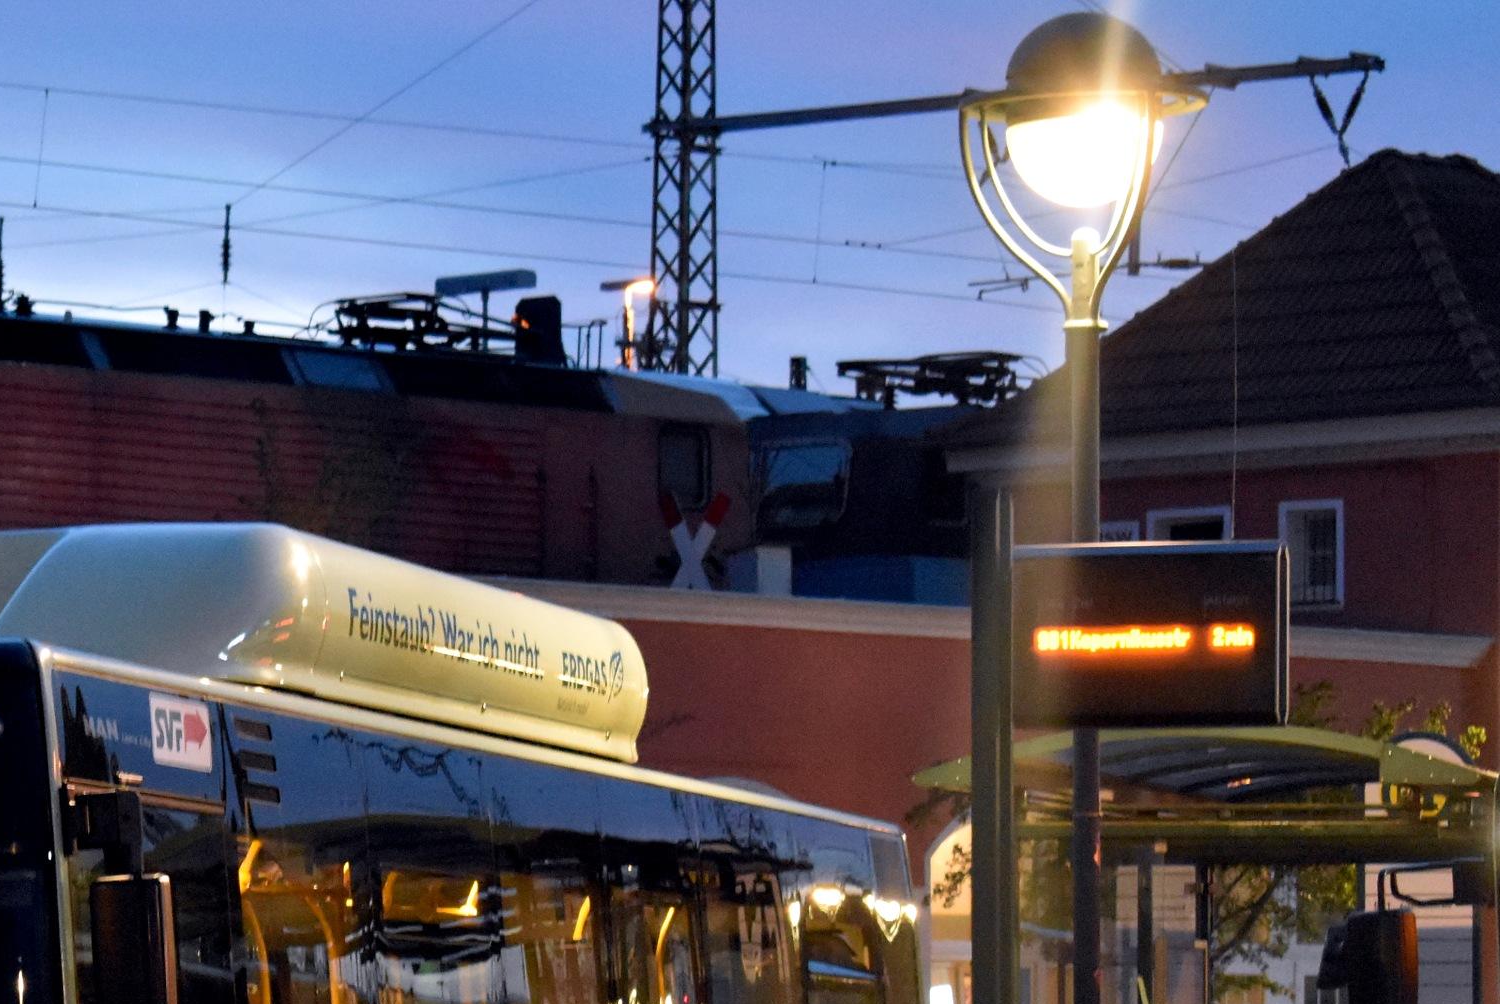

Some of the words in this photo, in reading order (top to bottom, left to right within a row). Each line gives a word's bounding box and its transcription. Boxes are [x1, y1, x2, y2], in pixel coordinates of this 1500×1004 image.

[348, 588, 435, 652] Feinstaub?
[439, 609, 474, 662] War
[476, 620, 499, 668] ich
[504, 629, 544, 680] nicht.
[561, 651, 608, 695] ERDGAS
